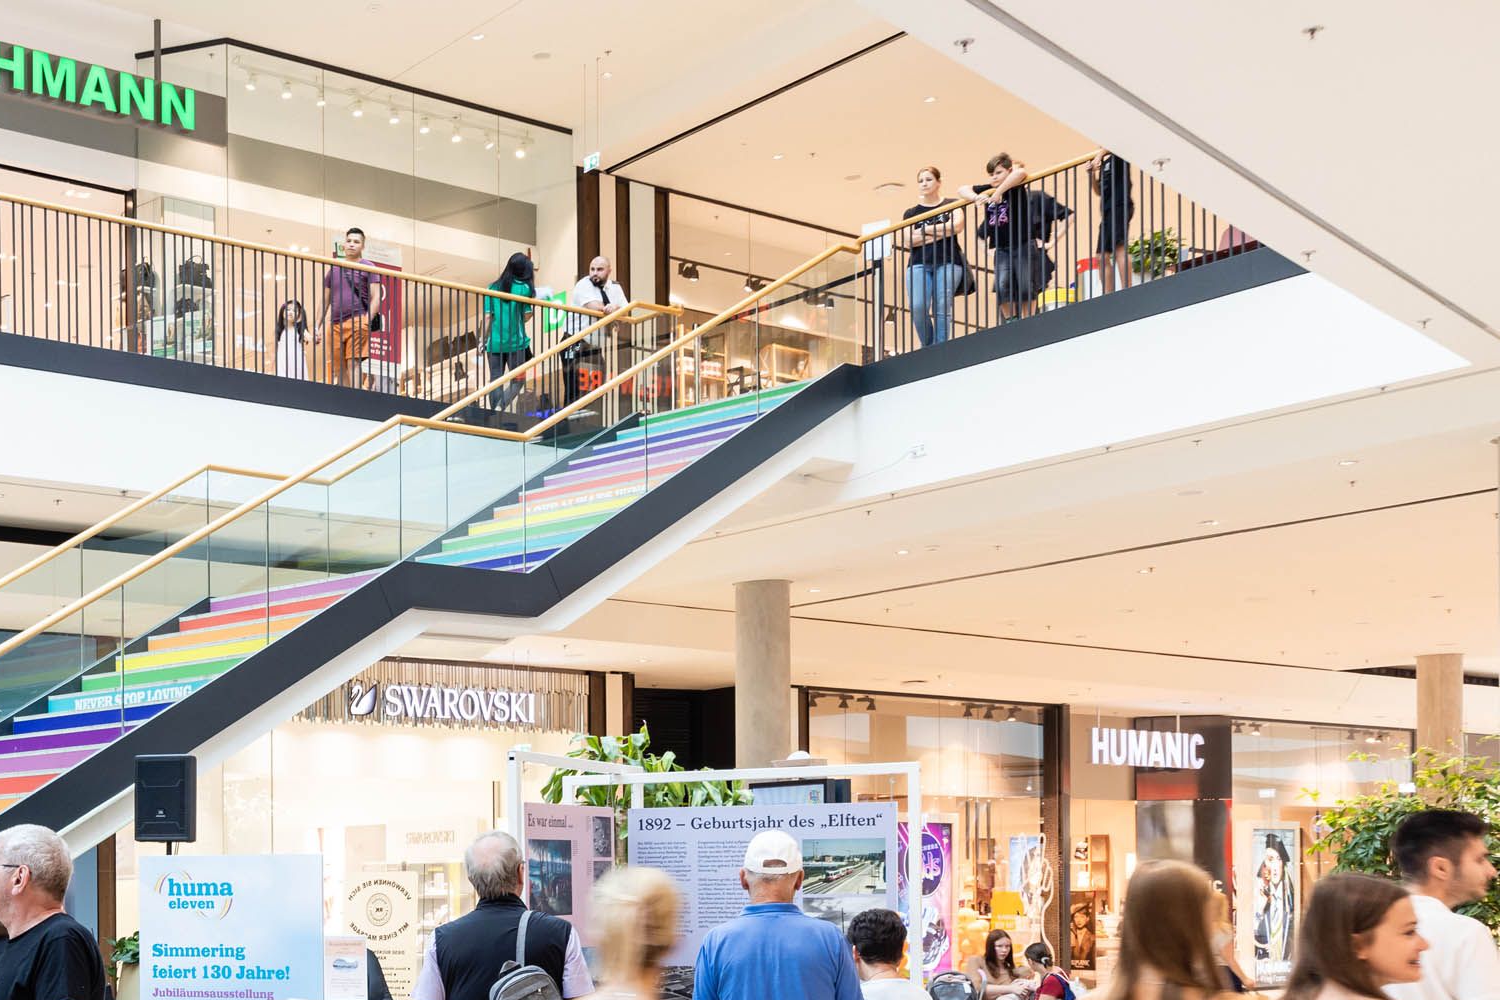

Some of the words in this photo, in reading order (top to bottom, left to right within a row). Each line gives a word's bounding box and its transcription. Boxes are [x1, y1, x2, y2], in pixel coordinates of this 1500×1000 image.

[74, 695, 113, 711] NEVER
[115, 691, 146, 706] STOP
[147, 685, 193, 702] LOVING
[385, 684, 535, 724] SWAROVSKI
[1092, 727, 1205, 770] HUMANIC
[528, 813, 535, 827] Es
[537, 816, 548, 827] war
[548, 815, 567, 828] einmal
[638, 818, 672, 831] 1892
[690, 815, 784, 831] Geburtsjahr
[788, 813, 815, 828] des
[820, 813, 883, 829] „Elften“
[167, 878, 234, 897] huma
[168, 898, 215, 910] eleven
[152, 943, 246, 960] Simmering
[152, 965, 197, 979] feiert
[202, 965, 232, 980] 130
[235, 965, 290, 980] Jahre!
[152, 987, 274, 1000] Jubiläumsausstellung
